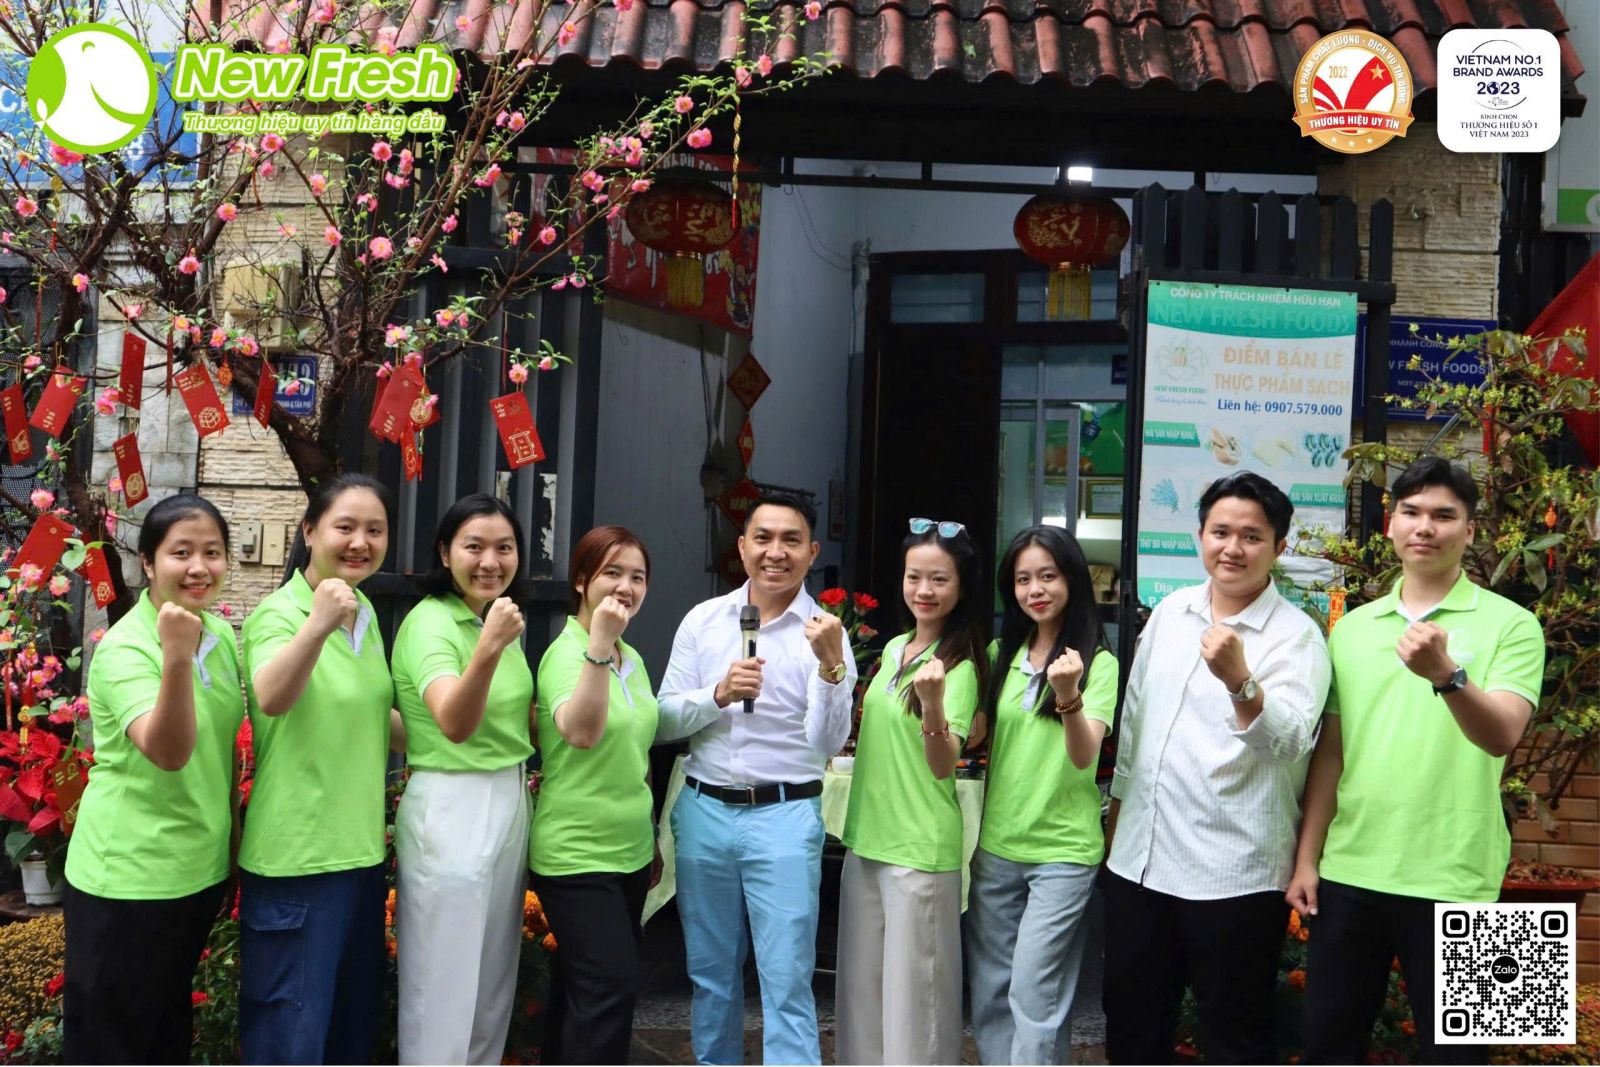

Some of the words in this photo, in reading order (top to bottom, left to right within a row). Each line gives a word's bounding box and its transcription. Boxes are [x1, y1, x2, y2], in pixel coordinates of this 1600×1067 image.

[1170, 287, 1201, 298] CÔNG
[1204, 290, 1217, 299] TY
[1219, 288, 1255, 302] TRÁCH
[1257, 292, 1291, 305] NHIỆM
[1154, 303, 1203, 325] NEW
[1210, 307, 1277, 329] FRESH
[1223, 340, 1271, 366] ĐIỂM
[1443, 363, 1486, 374] FOODS
[1214, 371, 1253, 395] THỰC
[1259, 367, 1303, 394] PHẨM
[1307, 380, 1350, 398] SẠCH
[1217, 399, 1241, 410] Liên
[1244, 400, 1261, 415] hệ:
[1264, 401, 1343, 416] 0907.579.000
